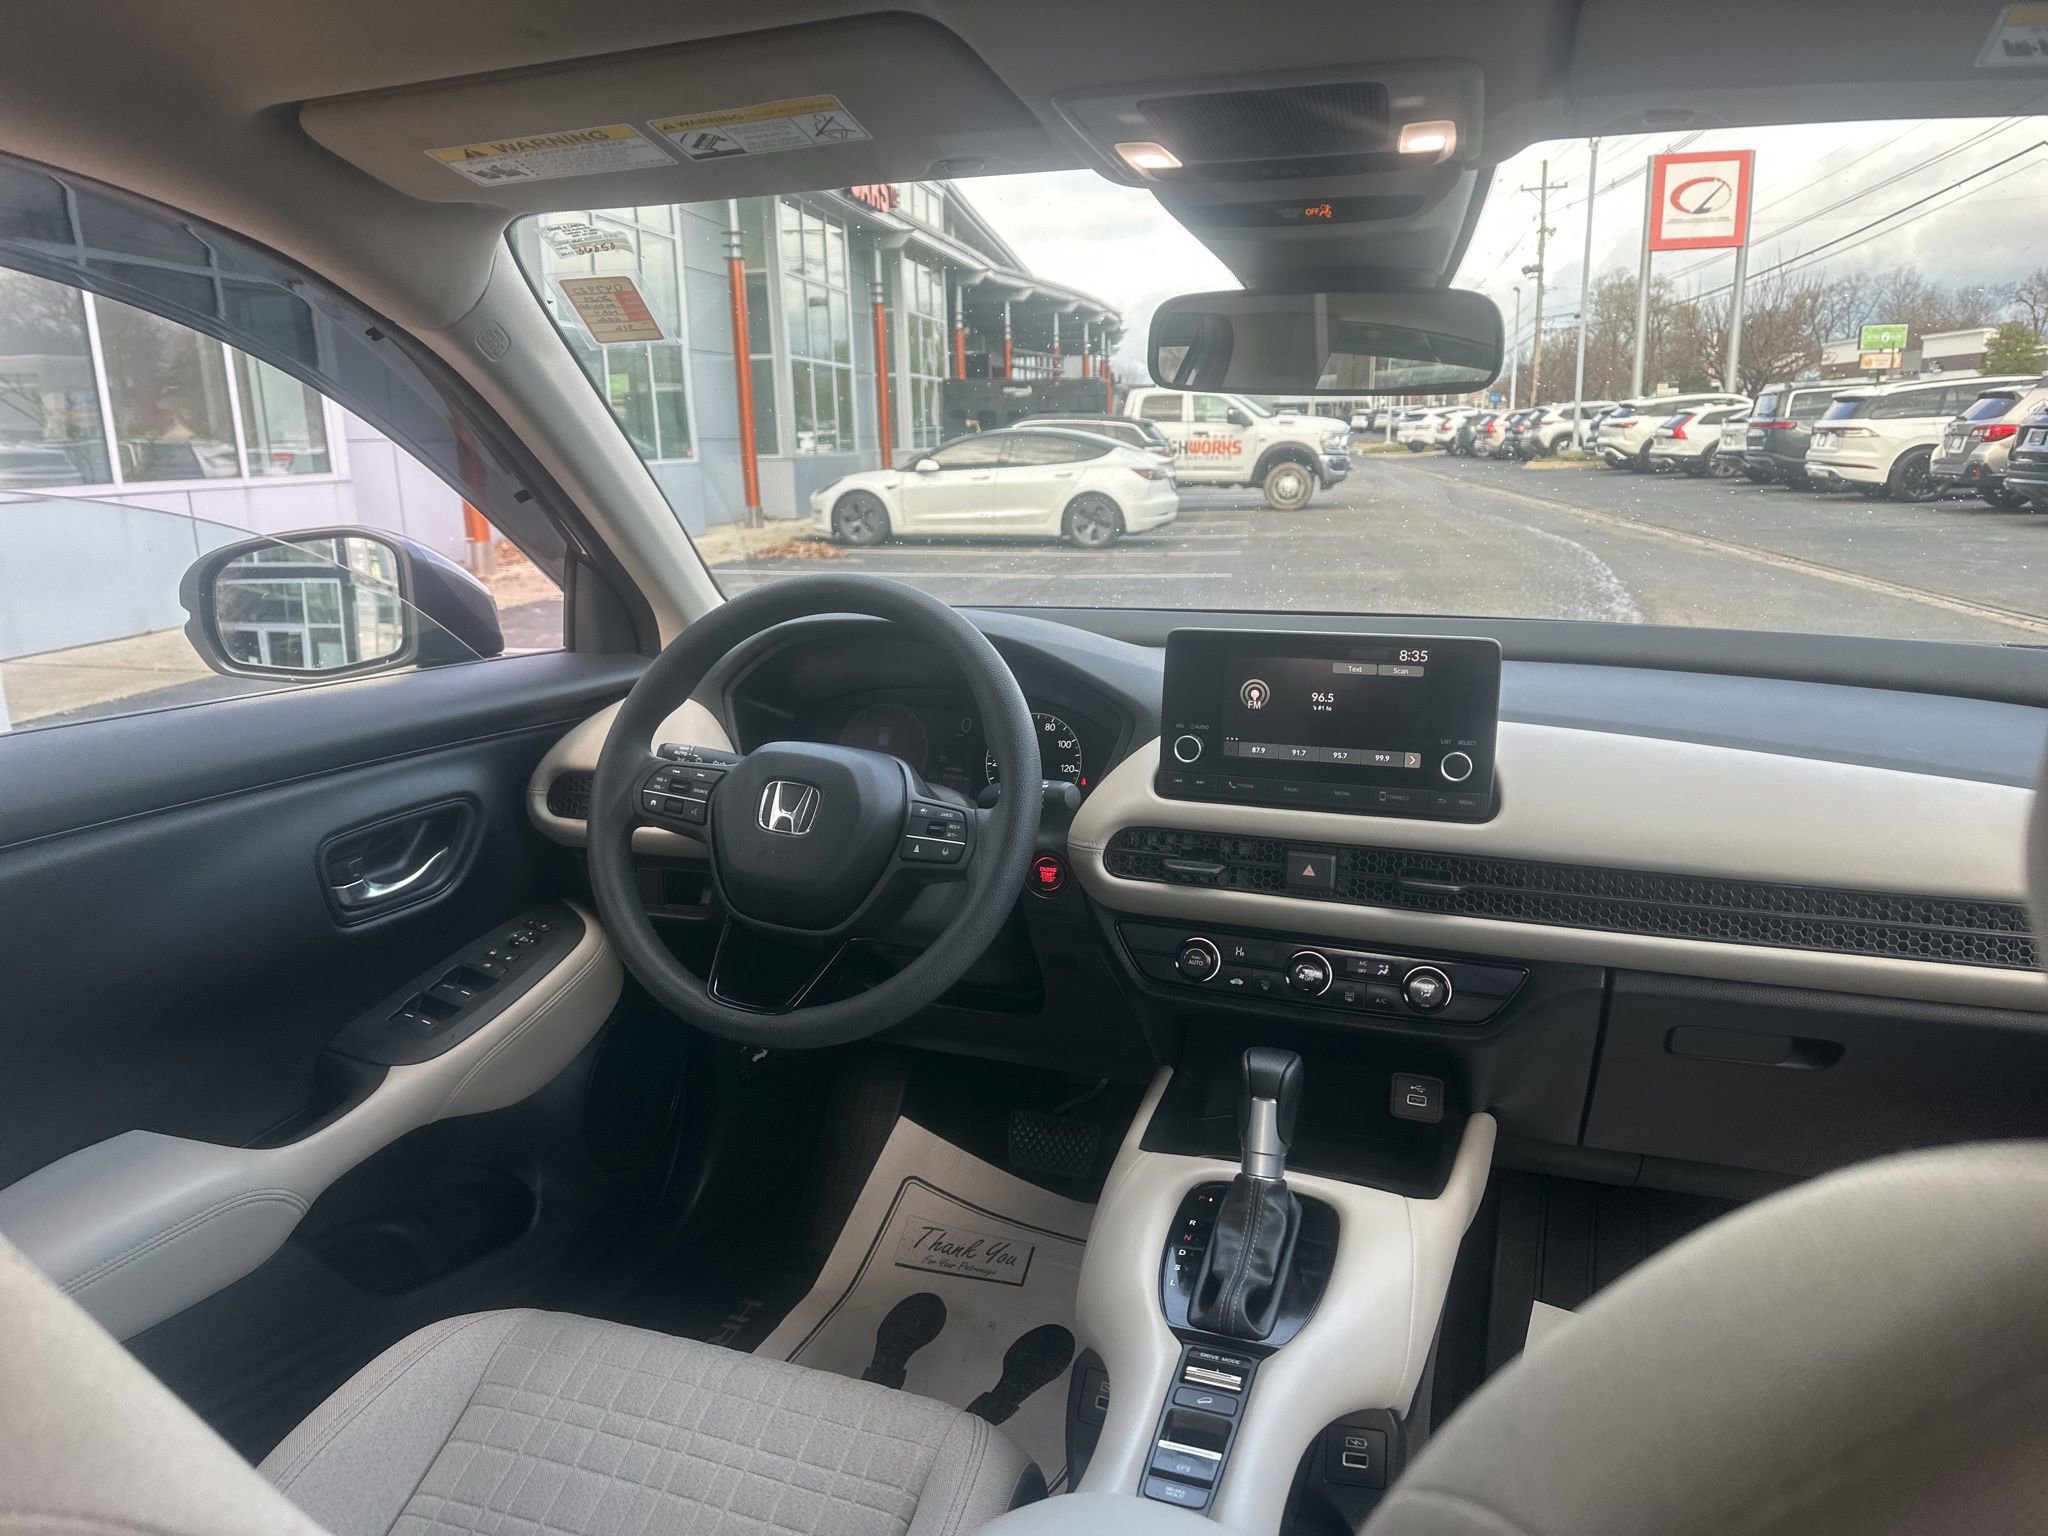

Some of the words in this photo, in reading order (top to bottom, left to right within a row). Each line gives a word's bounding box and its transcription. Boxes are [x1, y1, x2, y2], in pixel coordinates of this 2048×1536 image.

[491, 129, 611, 154] WARNING
[1304, 207, 1320, 216] OFF
[1399, 649, 1429, 662] 8:35
[1348, 665, 1363, 673] Text
[1393, 667, 1409, 675] Scan
[1311, 692, 1334, 703] 96.5
[1247, 700, 1262, 710] FM
[1044, 723, 1056, 732] 80
[1057, 740, 1072, 749] 100
[1251, 746, 1266, 754] 87.9
[1291, 749, 1307, 757] 91.7
[1333, 751, 1348, 760] 95.7
[1375, 754, 1390, 763] 99.9
[1060, 764, 1075, 773] 120
[1188, 959, 1204, 967] AUTO
[913, 1226, 985, 1259] Thank
[985, 1243, 1018, 1266] You
[1200, 1352, 1220, 1361] DRIVE
[1221, 1356, 1241, 1365] MODE
